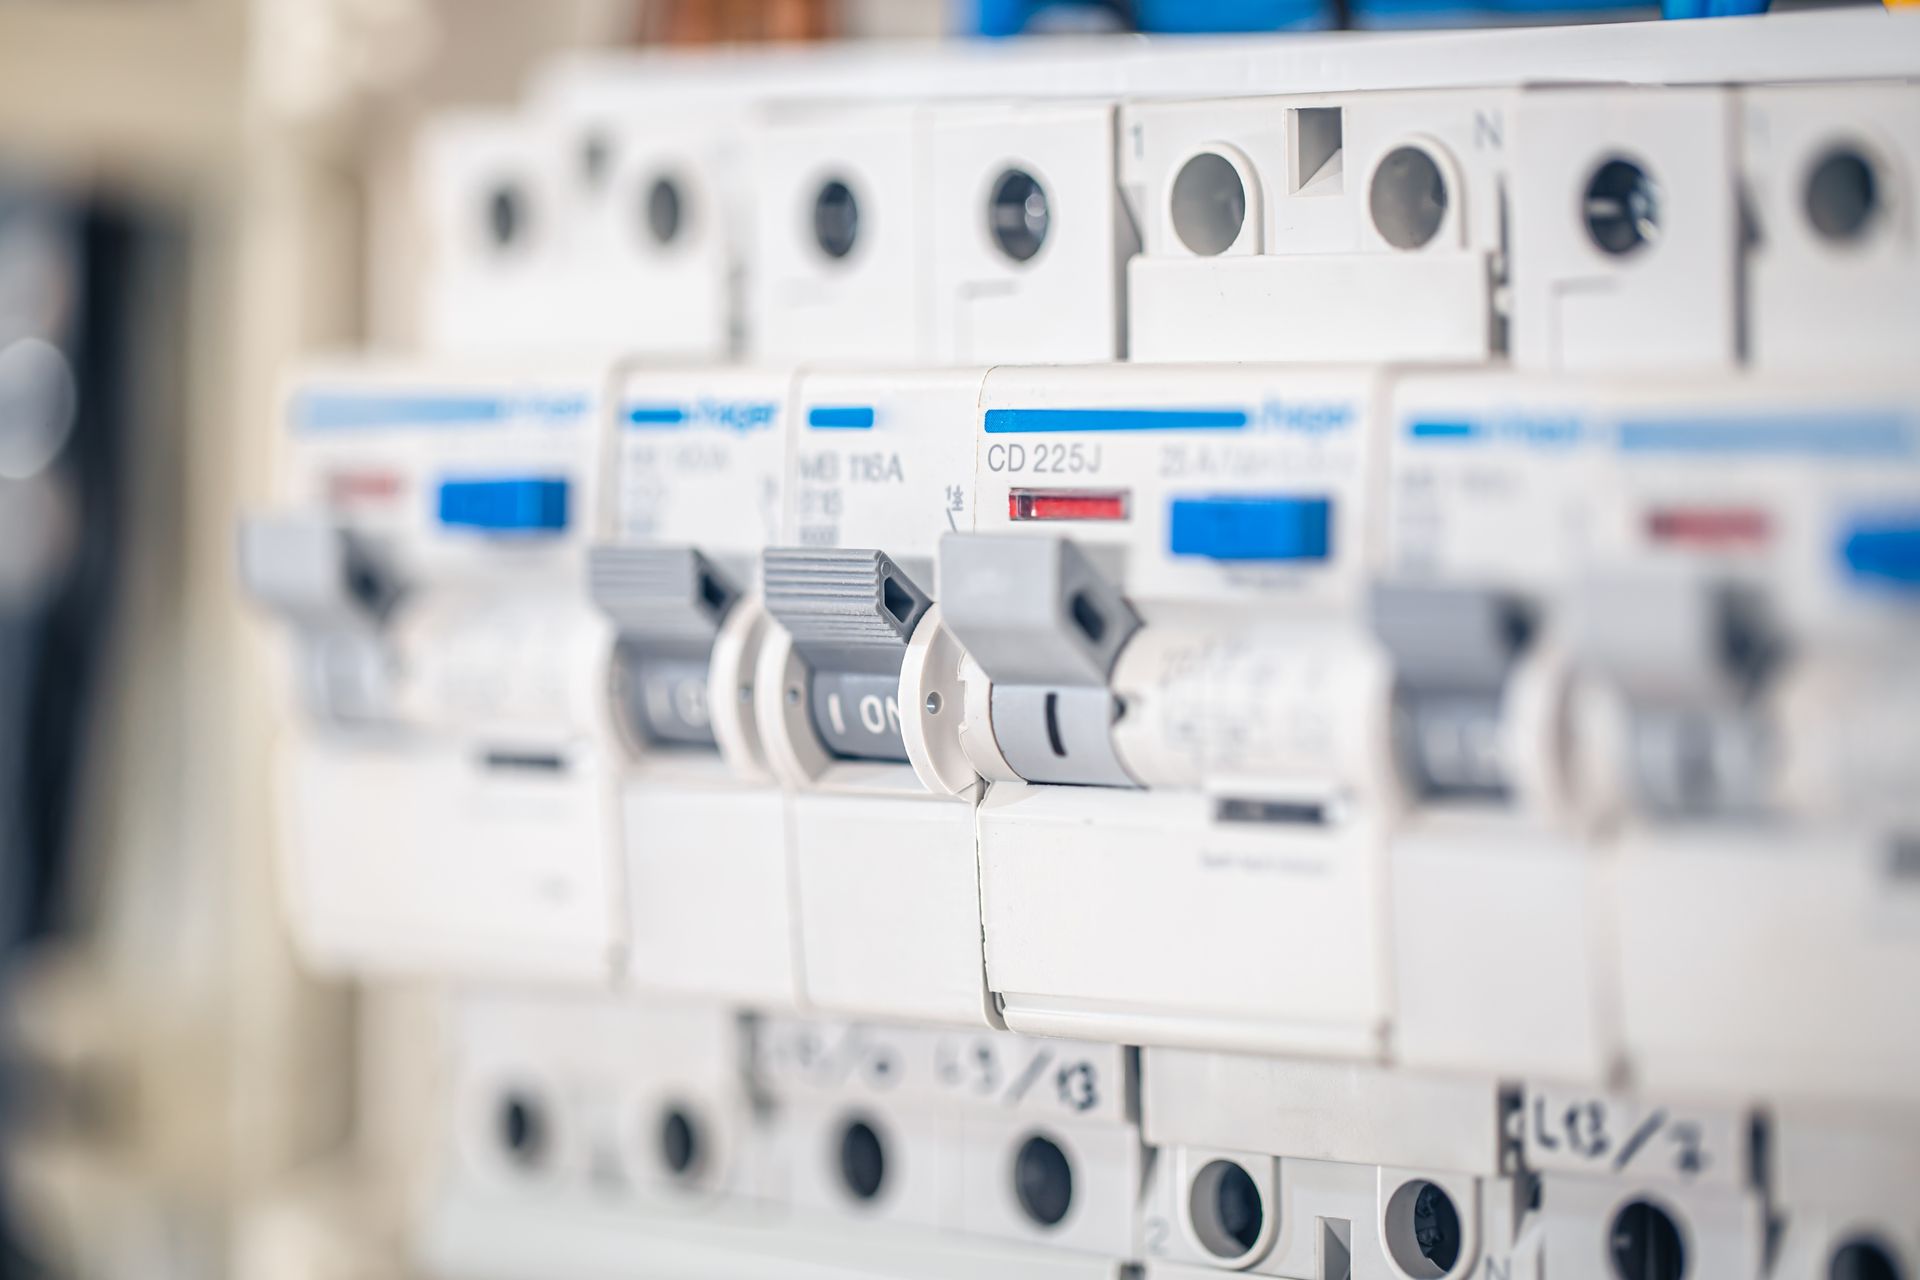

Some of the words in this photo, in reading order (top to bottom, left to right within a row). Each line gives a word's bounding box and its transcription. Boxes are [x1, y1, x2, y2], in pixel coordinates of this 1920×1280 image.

[1475, 110, 1501, 149] N
[987, 444, 1026, 473] CD
[1033, 444, 1104, 473] 225J
